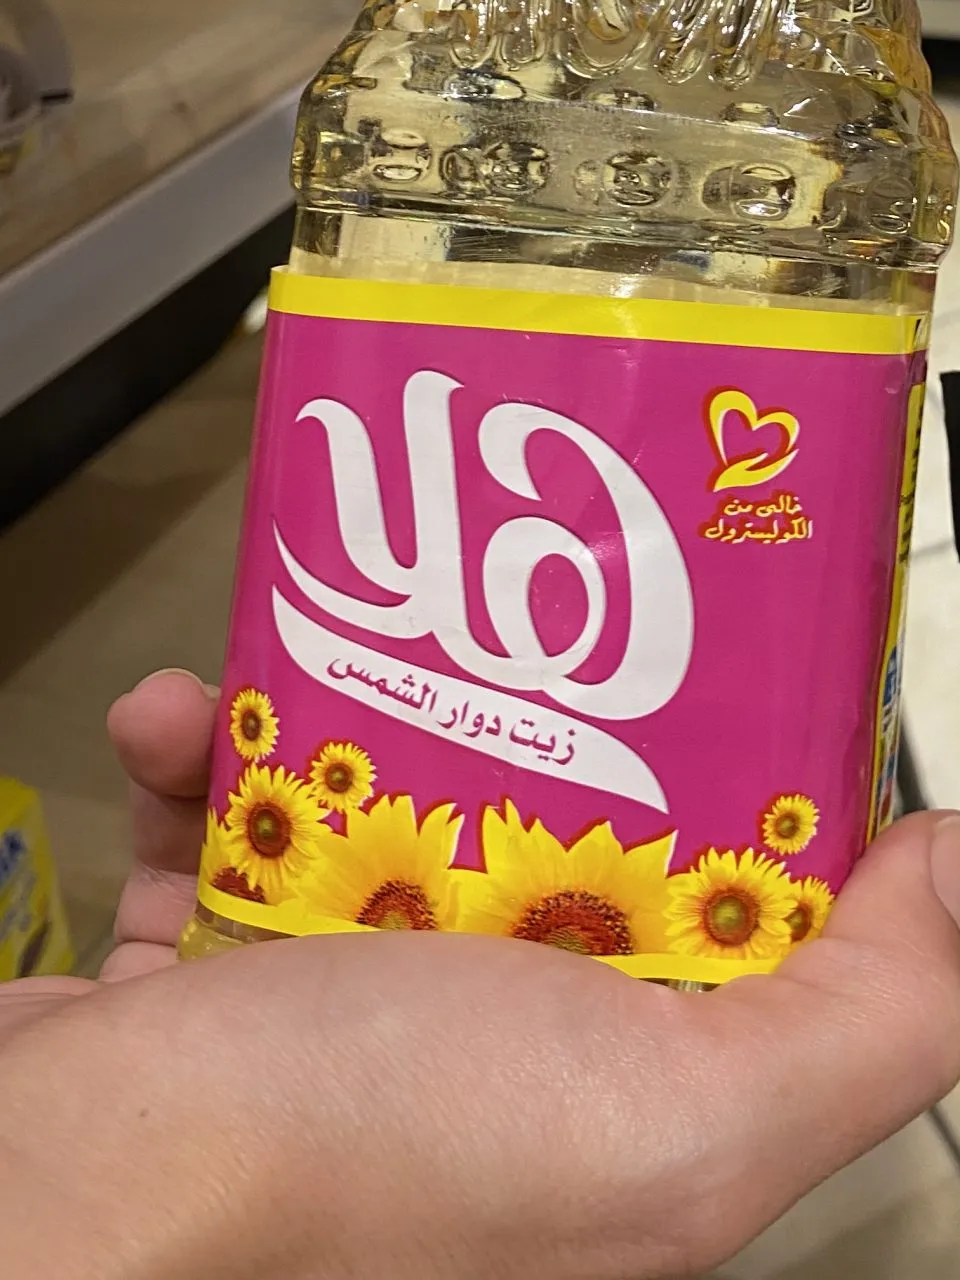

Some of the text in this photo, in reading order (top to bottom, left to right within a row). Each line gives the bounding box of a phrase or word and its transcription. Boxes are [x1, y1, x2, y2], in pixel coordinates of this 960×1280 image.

[705, 517, 812, 544] الكوليسترول
[724, 499, 753, 516] من
[272, 369, 695, 721] هلا
[326, 658, 575, 765] زيت دوار الشمس
